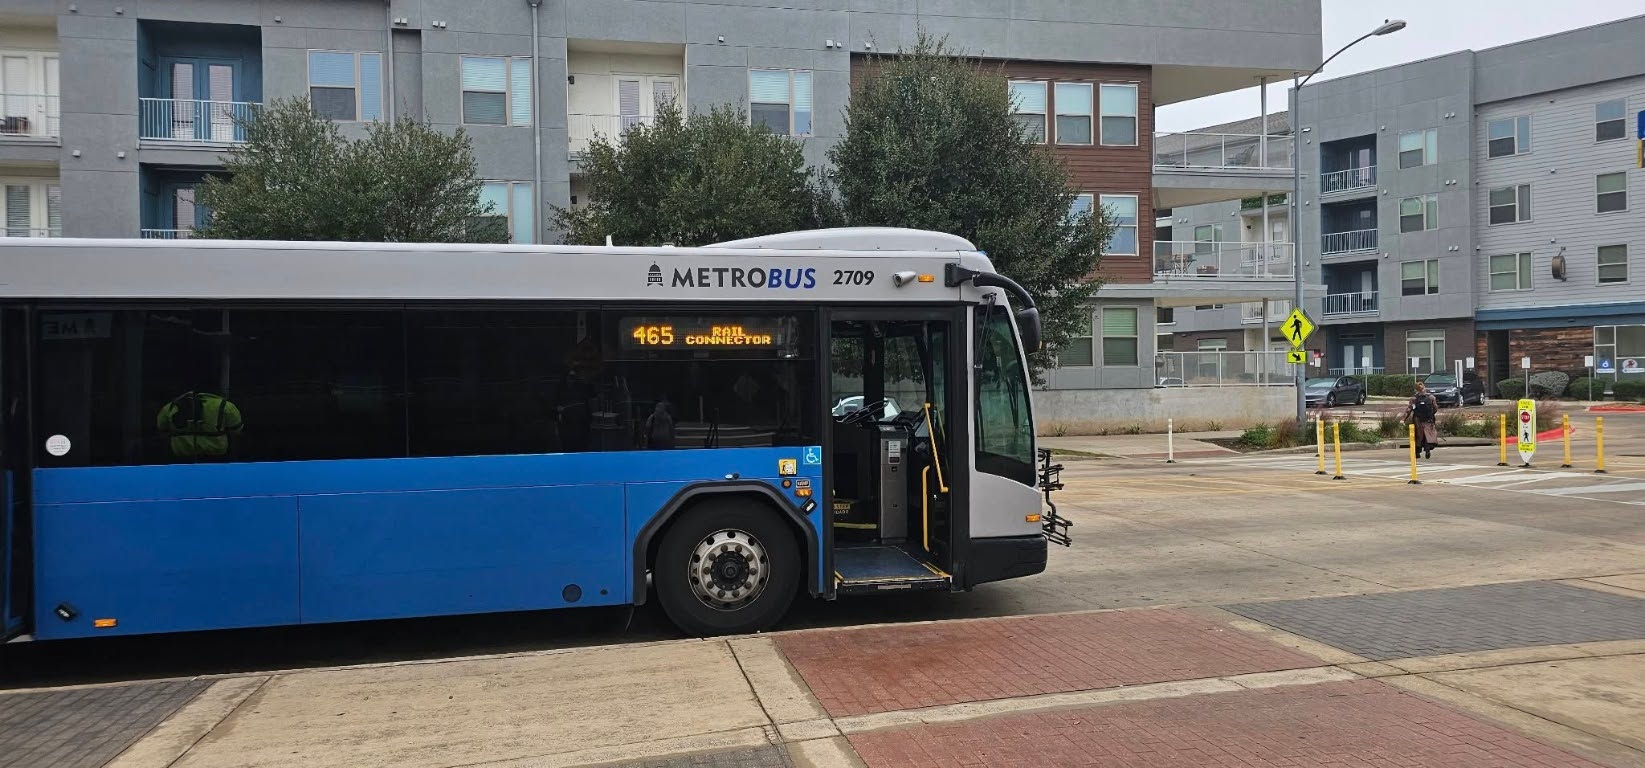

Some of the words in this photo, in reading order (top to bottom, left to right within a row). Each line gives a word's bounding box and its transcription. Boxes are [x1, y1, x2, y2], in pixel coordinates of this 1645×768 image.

[671, 267, 816, 289] METROBUS
[833, 269, 875, 286] 2709
[633, 326, 674, 345] 465
[685, 335, 772, 345] CONNECTOR
[712, 326, 747, 337] RAIL
